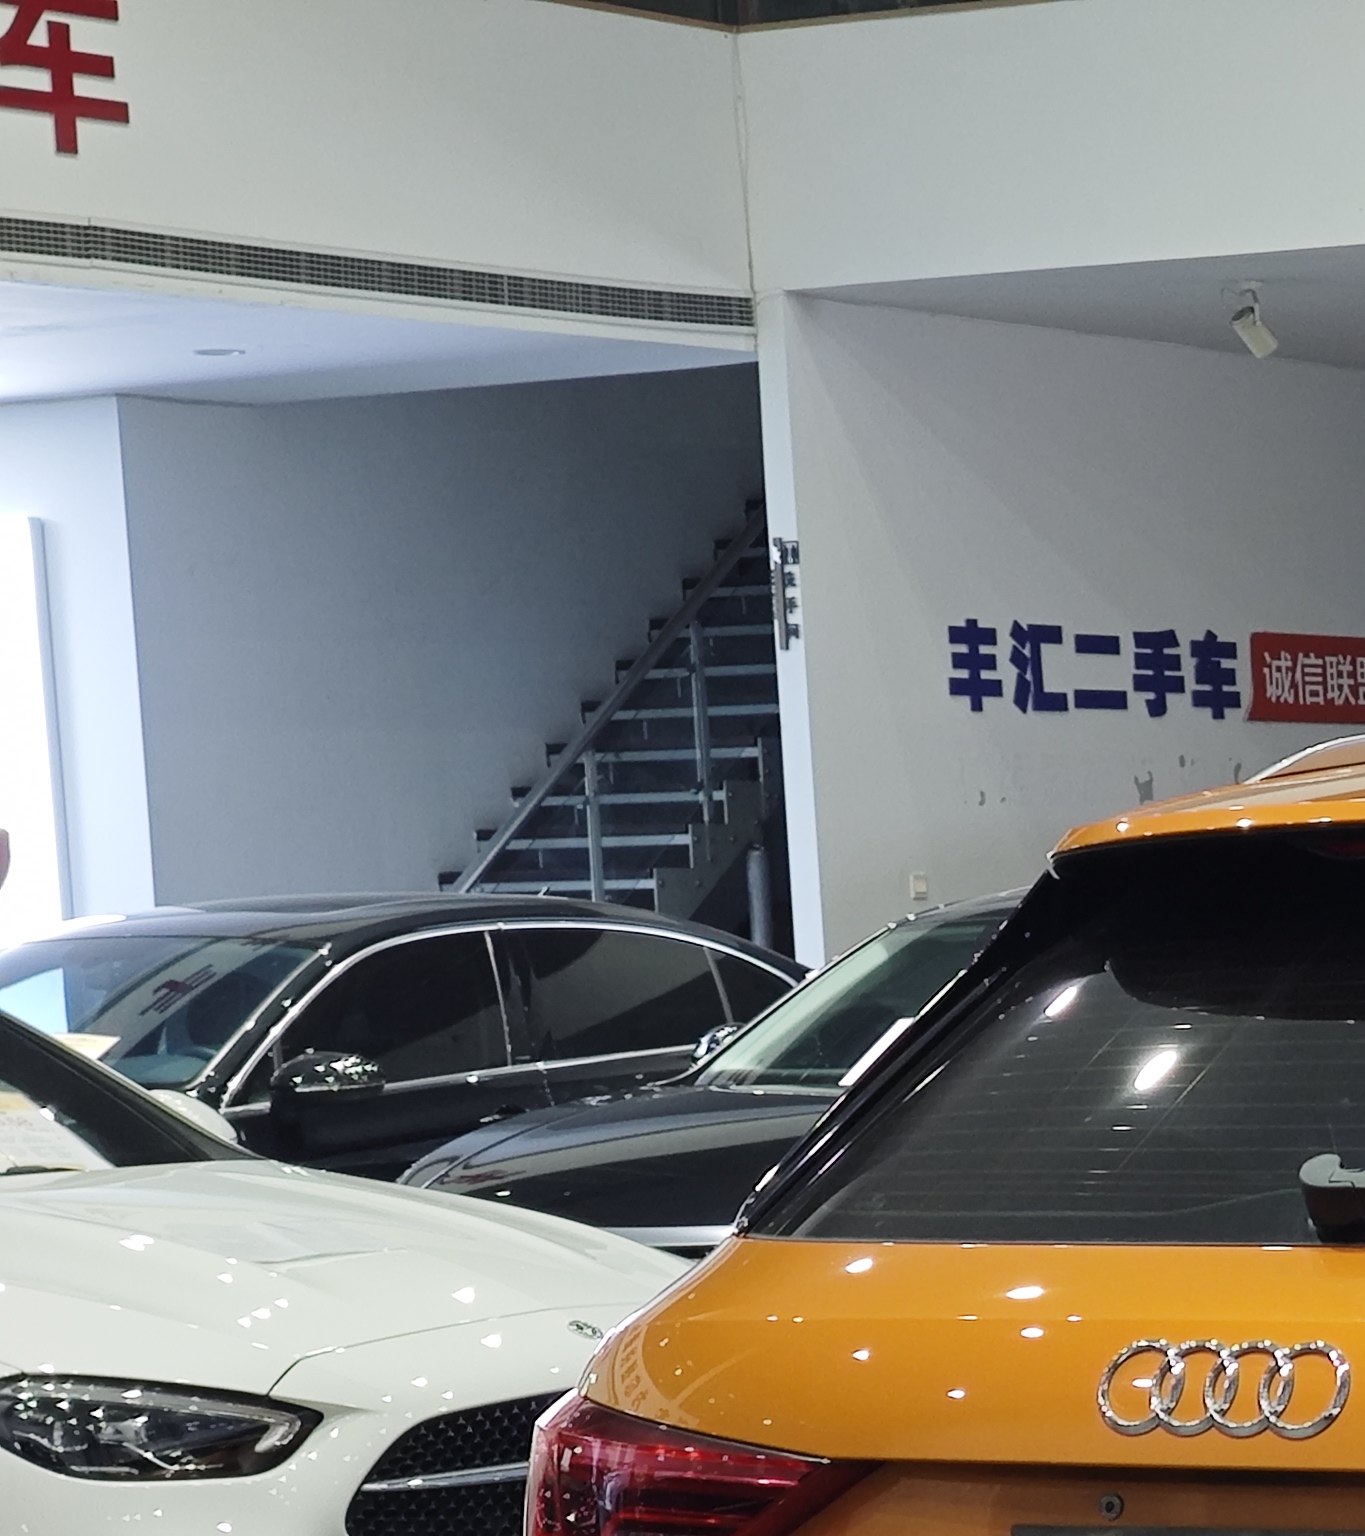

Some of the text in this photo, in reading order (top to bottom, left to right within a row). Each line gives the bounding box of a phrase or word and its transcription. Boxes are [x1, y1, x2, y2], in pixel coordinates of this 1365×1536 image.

[0, 0, 129, 154] 车
[948, 618, 1242, 720] 丰汇二手车
